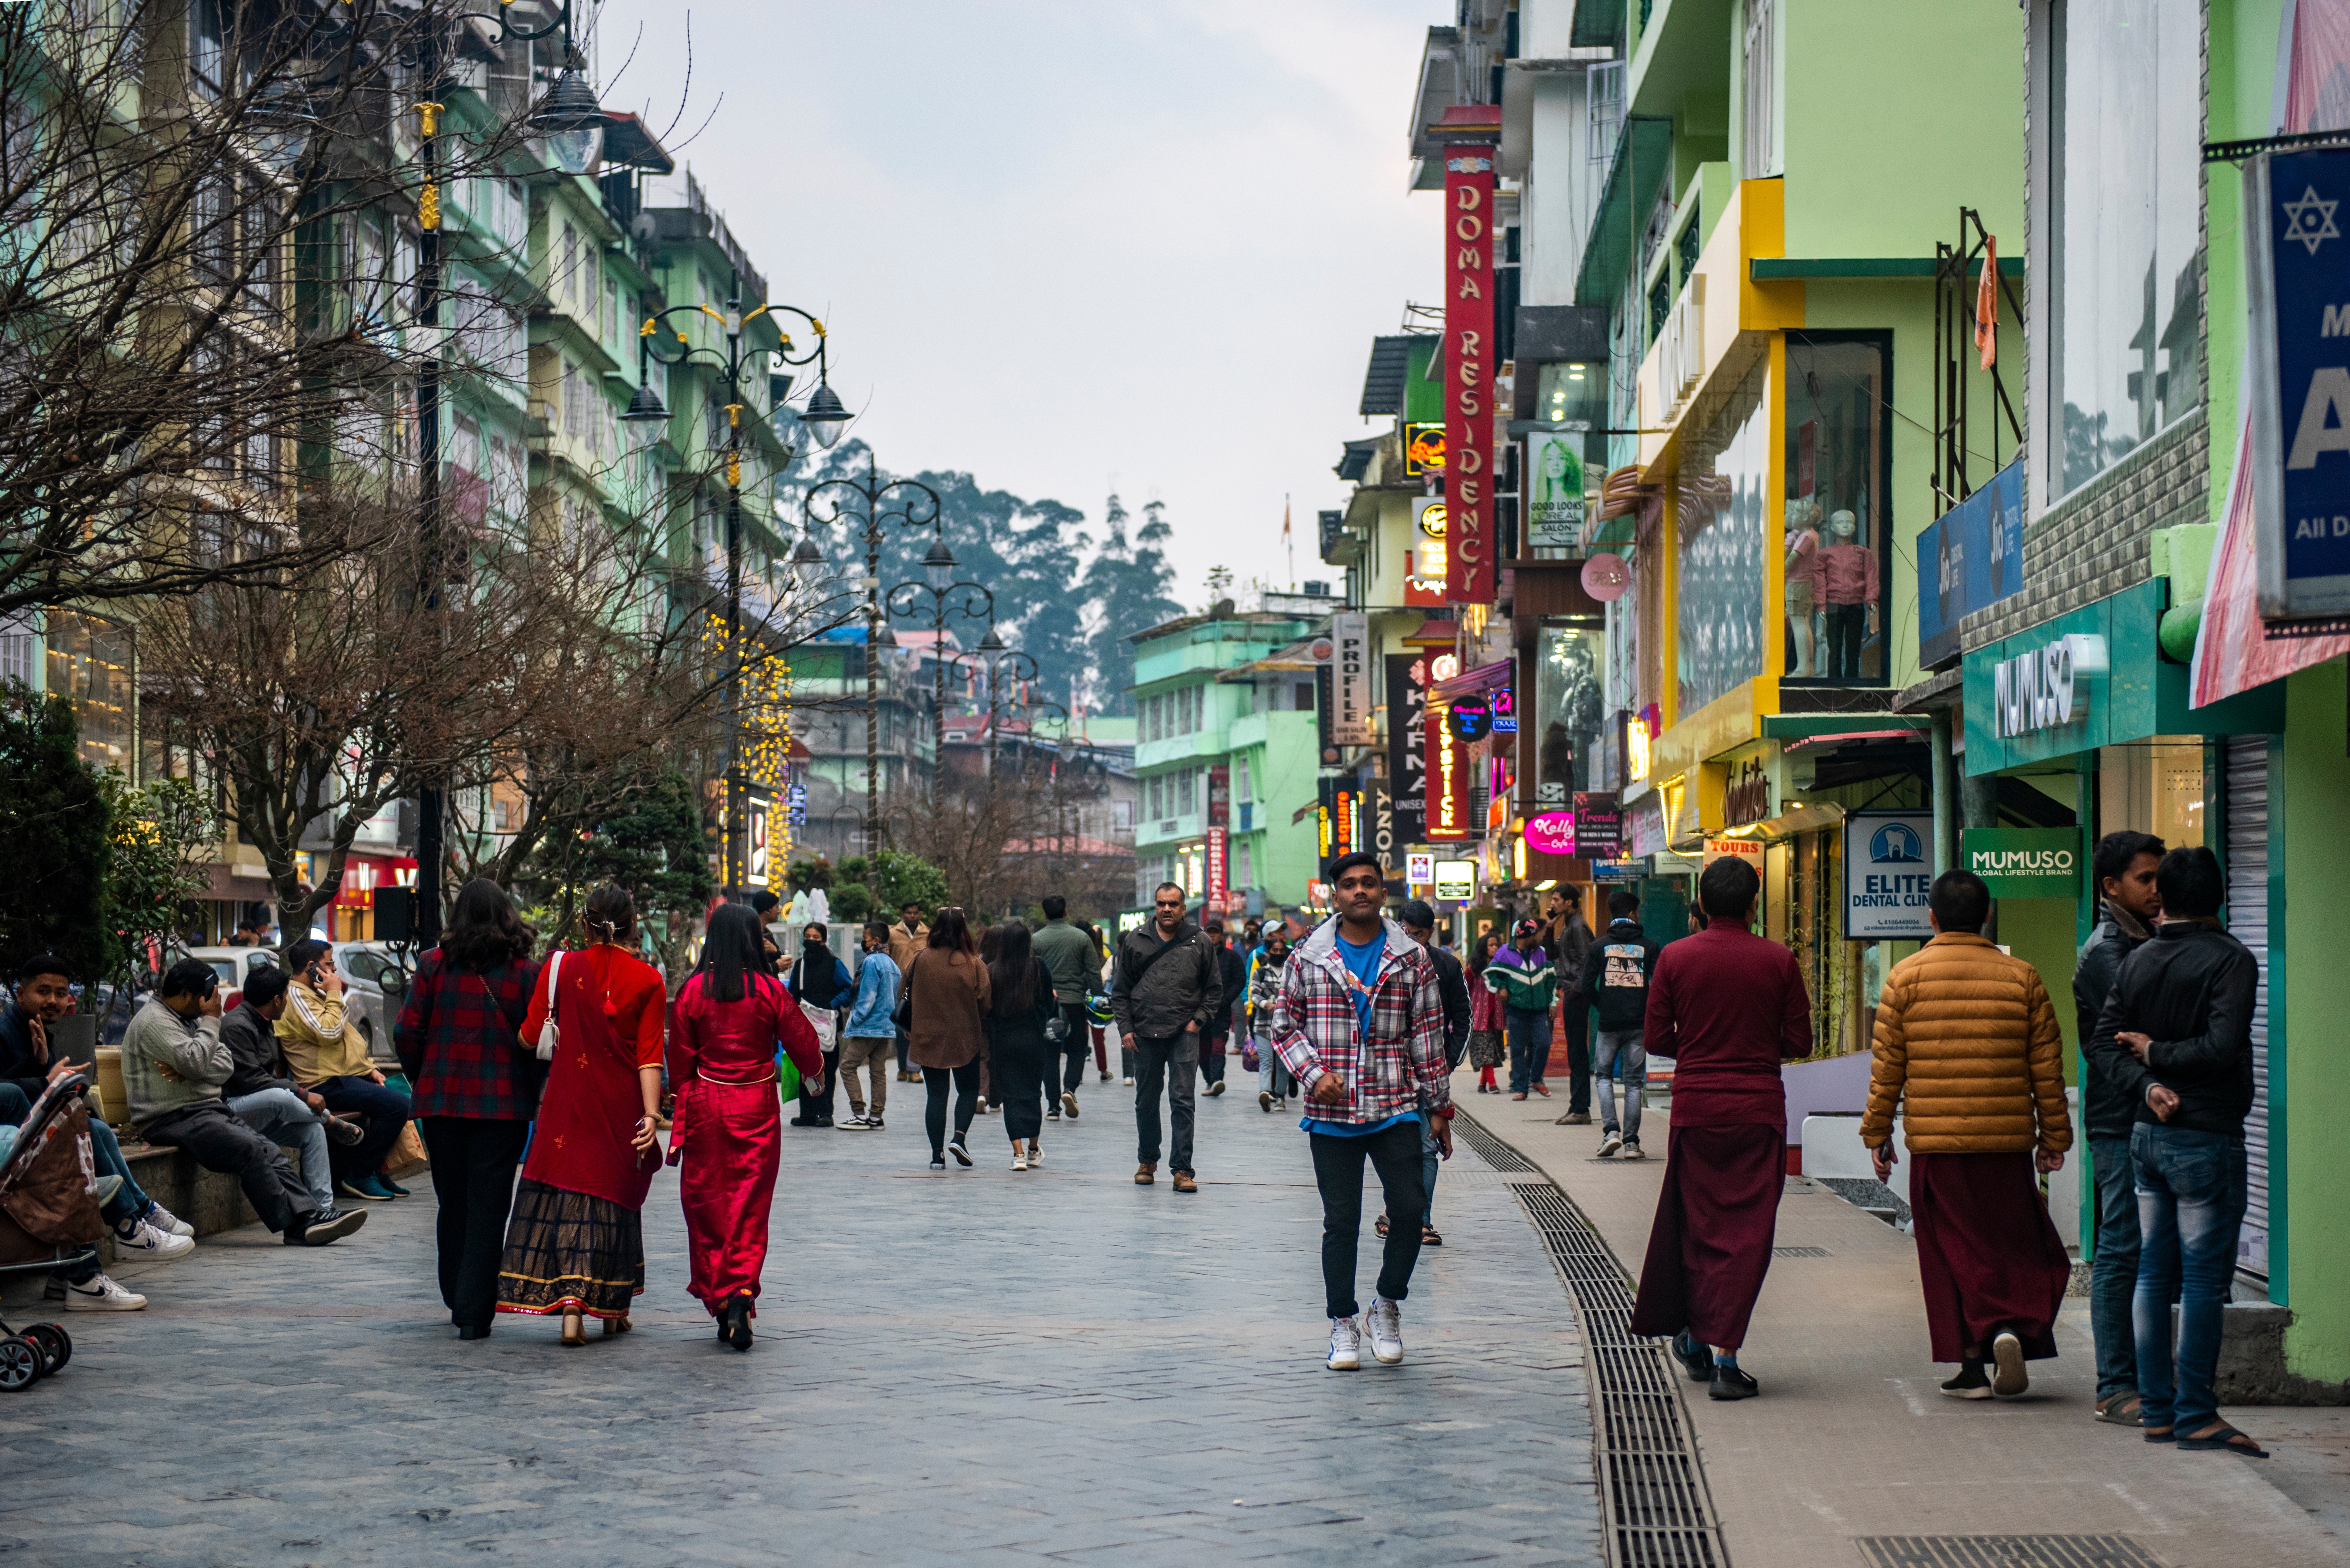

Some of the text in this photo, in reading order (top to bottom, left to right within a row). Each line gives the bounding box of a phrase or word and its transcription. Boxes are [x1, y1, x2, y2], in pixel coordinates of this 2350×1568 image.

[1456, 186, 1482, 593] DOMA RESIDENCY
[1530, 501, 1582, 511] GOOD LOOKS
[1991, 505, 2019, 565] Jio DIGITAL
[2295, 516, 2326, 539] All
[2005, 533, 2014, 556] LIFE
[1939, 543, 1963, 595] Jio DIGITAL
[1343, 639, 1359, 722] PROFILE
[1995, 634, 2075, 739] MUMUSO
[1337, 791, 1351, 843] square
[1579, 808, 1618, 823] Trends
[1376, 787, 1393, 869] SONY
[1551, 839, 1568, 849] Cafe
[1711, 841, 1758, 853] TOURS
[1972, 850, 2073, 869] MUMUSO
[1866, 874, 1930, 893] ELITE
[1853, 894, 1930, 907] DENTAL CLIN
